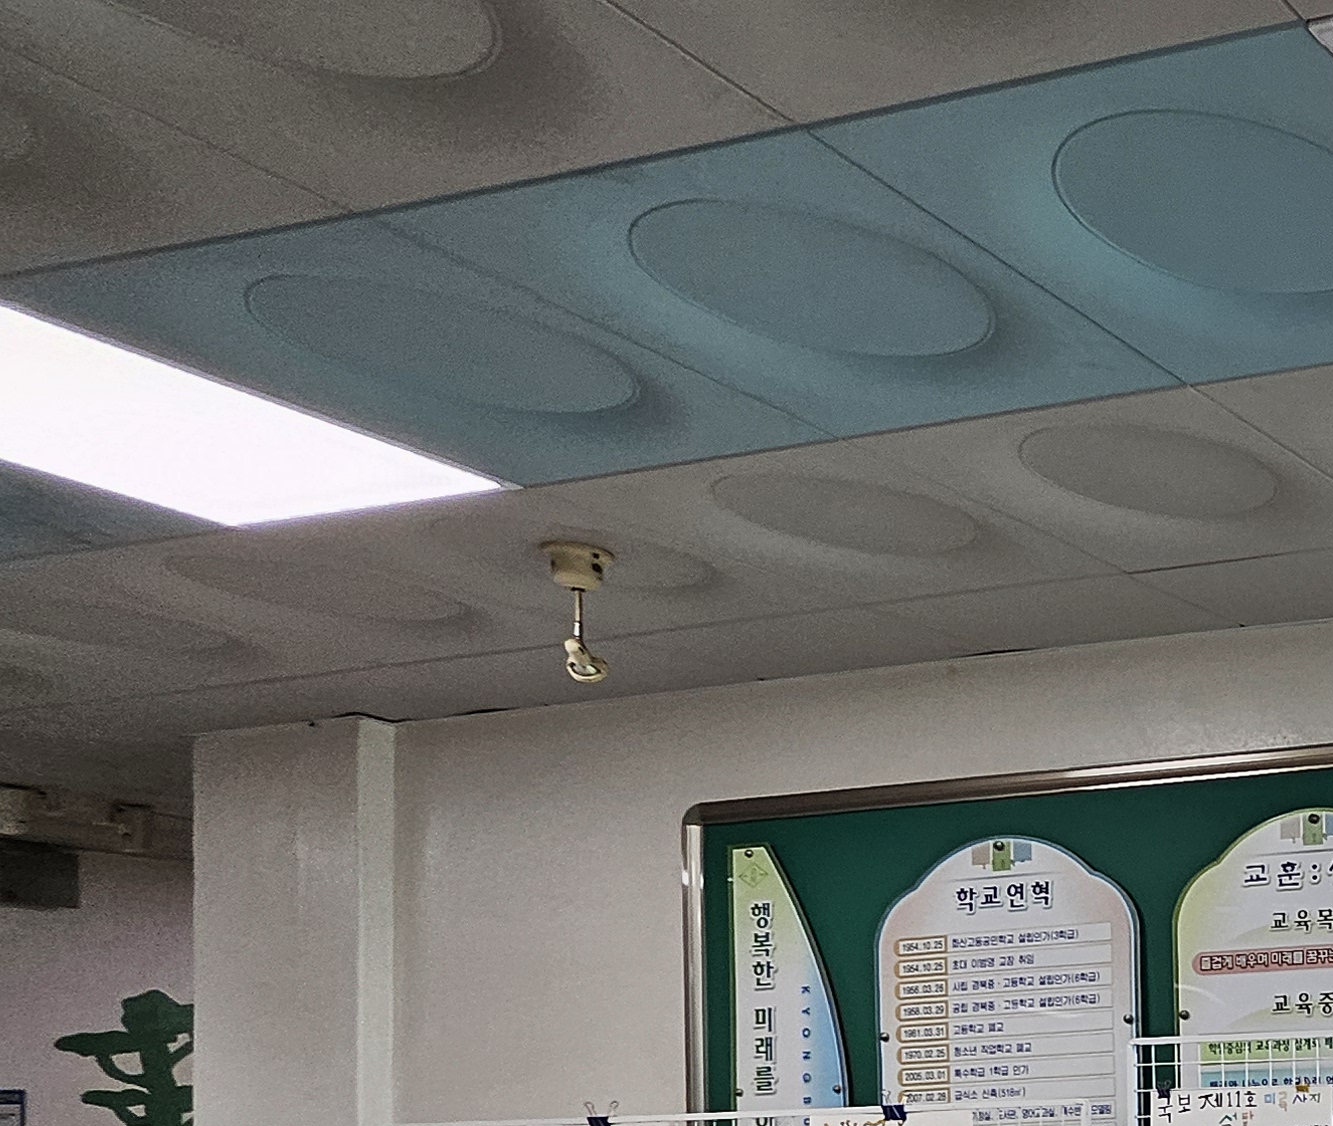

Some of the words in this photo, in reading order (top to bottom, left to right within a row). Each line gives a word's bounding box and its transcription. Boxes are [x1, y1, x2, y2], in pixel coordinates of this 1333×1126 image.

[955, 880, 1051, 912] 학교연혁
[750, 902, 774, 988] 행복한
[952, 960, 968, 971] 초대
[999, 955, 1015, 967] 교장
[1019, 953, 1035, 965] 취임
[1235, 953, 1269, 968] 배우며
[1271, 951, 1304, 966] 미래를
[1003, 977, 1035, 988] 고등학교
[1003, 999, 1035, 1010] 고등학교
[953, 1024, 984, 1035] 고등학교
[988, 1022, 1004, 1032] 폐교
[754, 1007, 774, 1093] 미래를
[954, 1045, 977, 1057] 청소년
[981, 1043, 1013, 1055] 직업학교
[1016, 1042, 1032, 1053] 폐교
[954, 1067, 985, 1078] 특수학급
[989, 1065, 1009, 1077] 1학급
[1013, 1064, 1029, 1075] 인가
[954, 1089, 978, 1100] 급식소
